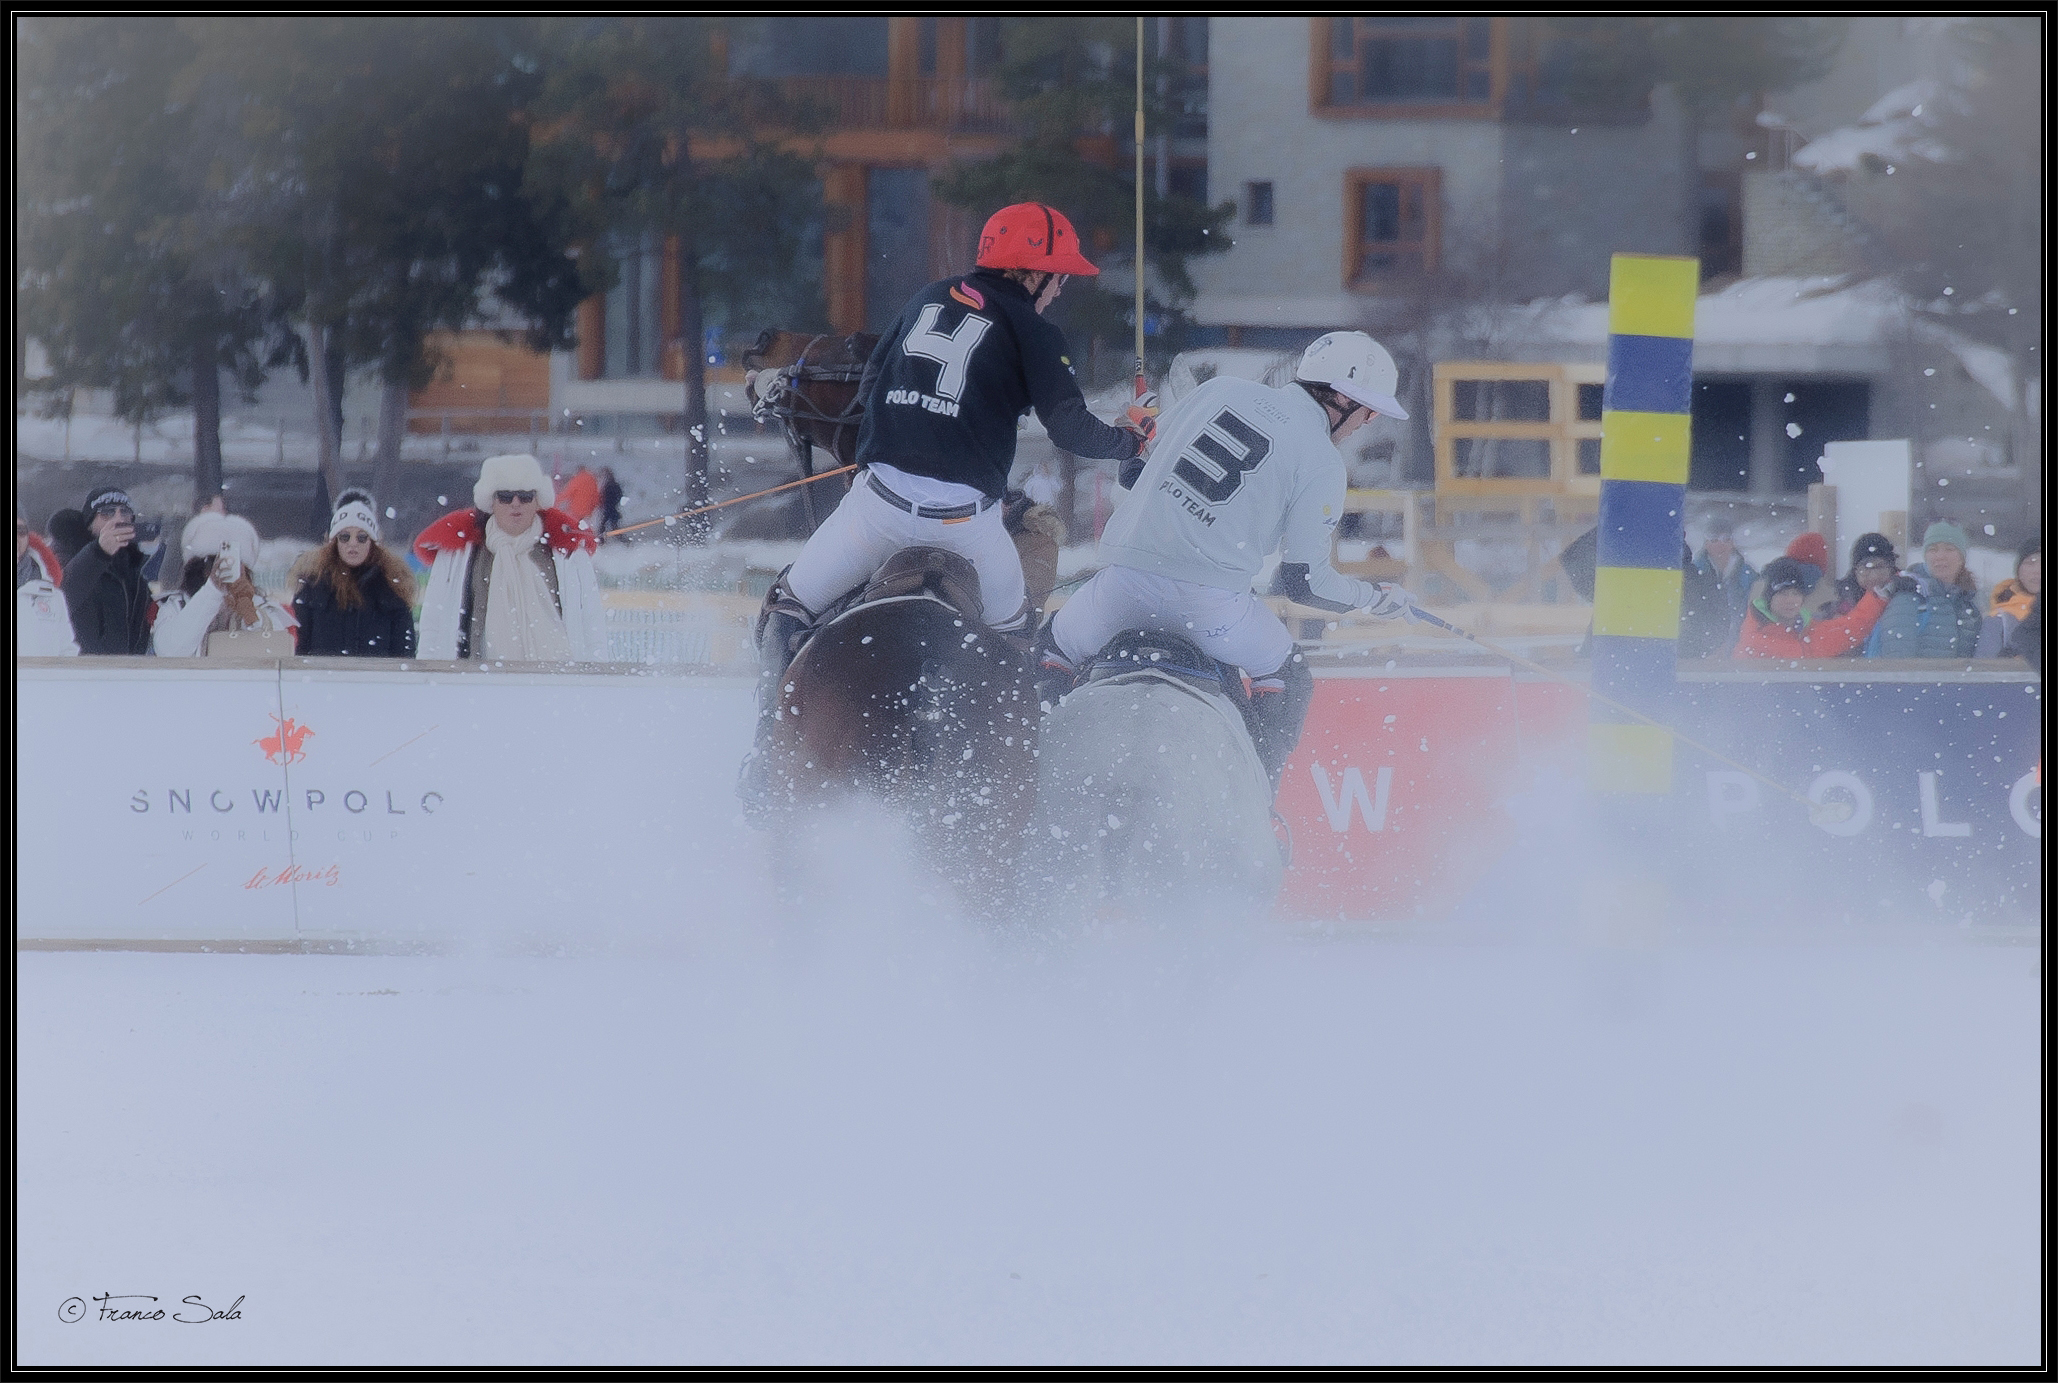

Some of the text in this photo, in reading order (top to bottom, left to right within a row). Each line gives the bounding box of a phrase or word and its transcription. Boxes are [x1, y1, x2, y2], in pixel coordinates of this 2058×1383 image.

[902, 303, 993, 403] 4
[885, 389, 960, 418] POLO TEAM
[1168, 404, 1275, 508] 3
[1181, 495, 1217, 528] TEAM
[181, 829, 399, 842] WORLD CUP
